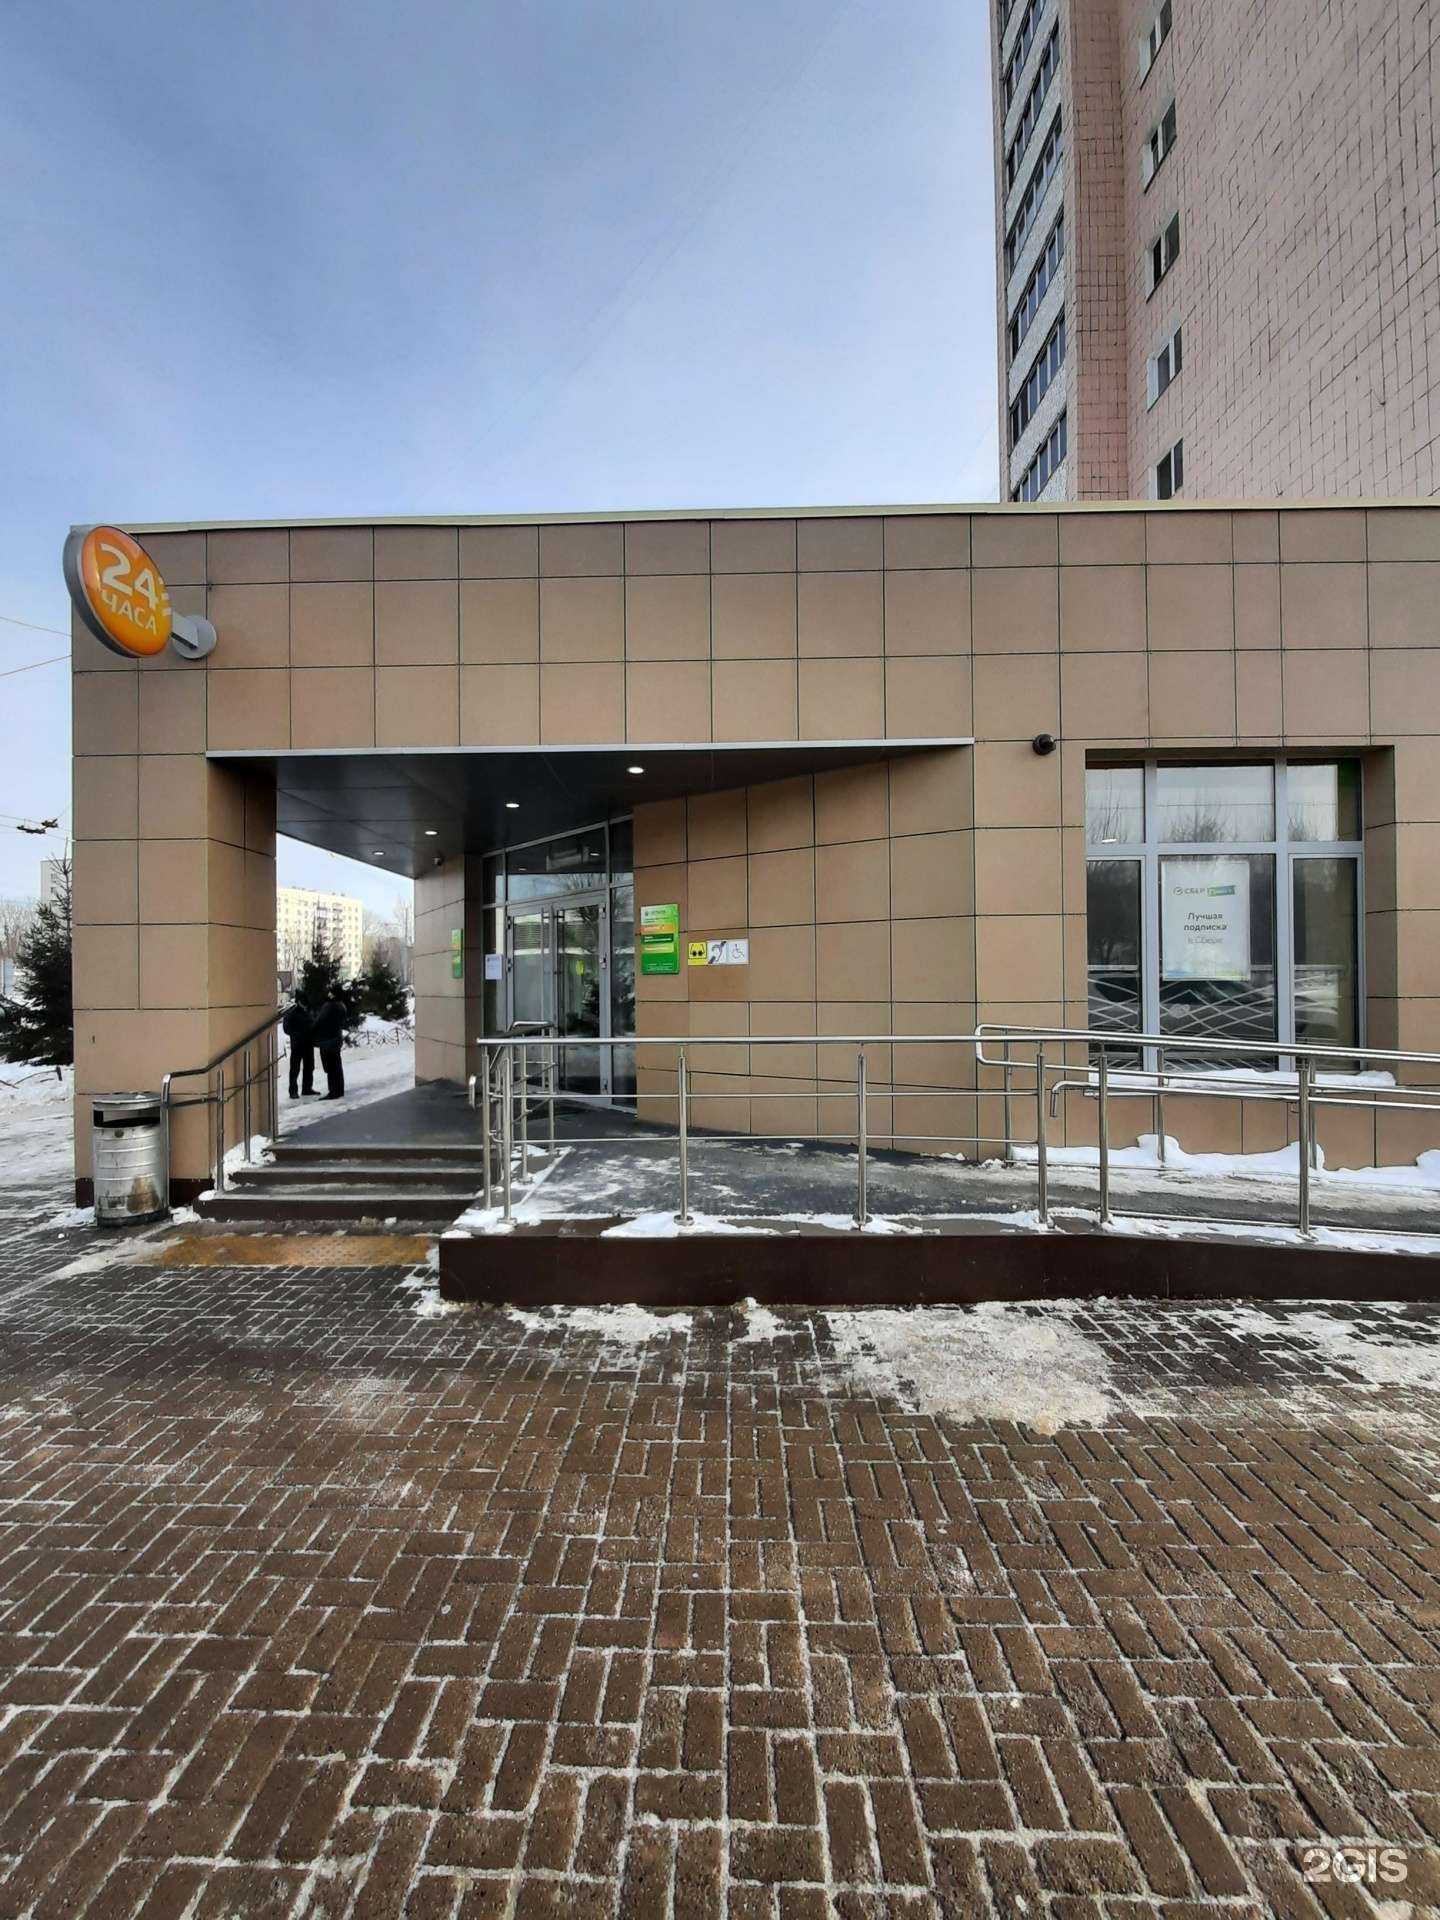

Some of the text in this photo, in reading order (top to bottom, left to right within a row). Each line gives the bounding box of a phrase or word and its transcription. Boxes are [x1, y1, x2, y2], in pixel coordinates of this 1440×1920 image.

[100, 543, 159, 610] 24
[101, 589, 158, 635] ЧАСА
[1183, 924, 1228, 932] подписка
[1187, 912, 1223, 921] Лучшая
